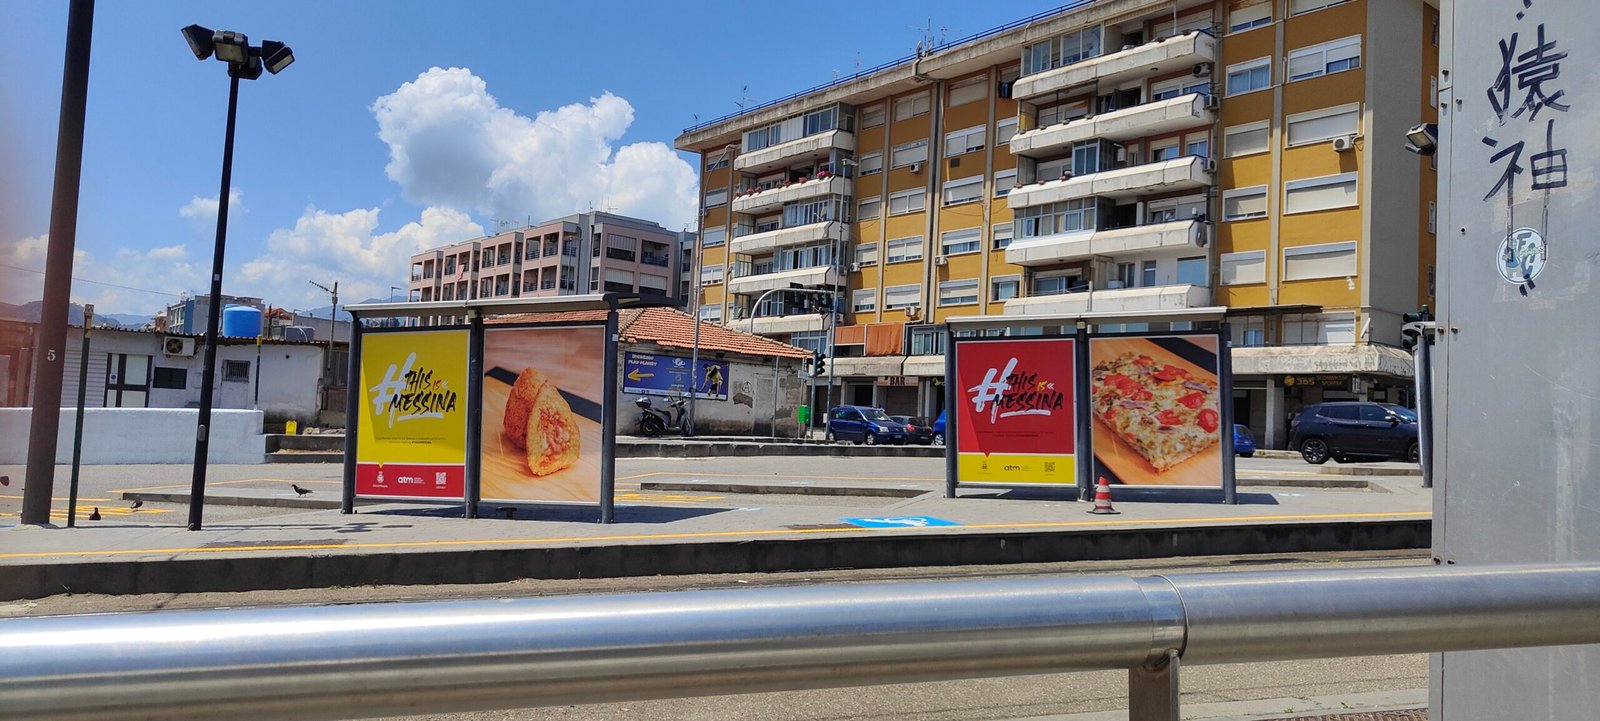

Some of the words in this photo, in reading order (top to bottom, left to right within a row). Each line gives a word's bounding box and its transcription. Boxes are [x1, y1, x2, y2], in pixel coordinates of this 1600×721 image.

[47, 349, 56, 361] 5
[890, 376, 906, 385] BAR
[388, 390, 457, 415] MESSINA
[990, 390, 1064, 412] MESSINA
[397, 476, 414, 484] atm
